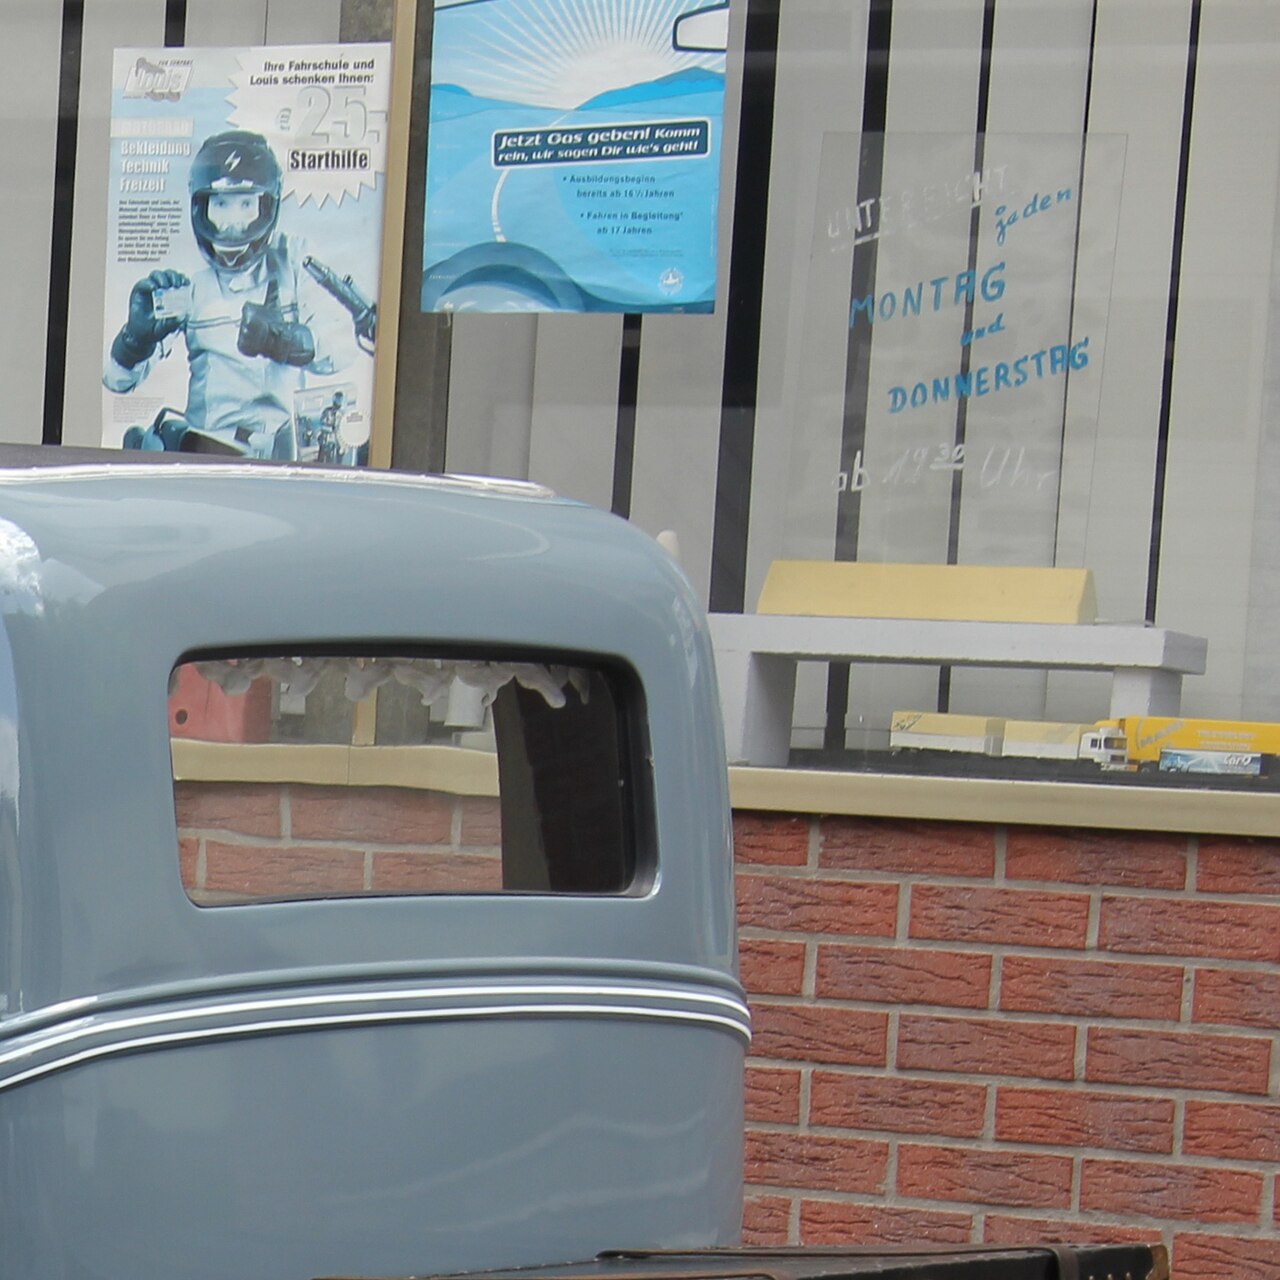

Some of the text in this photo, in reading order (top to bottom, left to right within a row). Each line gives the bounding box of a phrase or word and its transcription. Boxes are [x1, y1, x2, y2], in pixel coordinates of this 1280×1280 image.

[264, 59, 375, 72] Ihre Fahrschule und
[250, 73, 374, 86] Louis schenken Ihnen:
[498, 127, 700, 150] Jetzt Gas geben! Komm
[121, 140, 192, 156] Bekleidung
[498, 140, 698, 162] rein, wir sagen Dir wie's geht!
[121, 159, 169, 174] Technik
[290, 150, 368, 169] Starthilfe
[120, 178, 166, 192] Freizeit
[569, 174, 656, 184] Ausbildungsbeginn
[576, 189, 607, 198] bereits
[610, 189, 621, 198] ab
[644, 190, 675, 198] Jahren
[586, 211, 618, 220] Fahren
[621, 211, 629, 219] in
[597, 226, 608, 234] ab
[623, 226, 653, 235] Jahren
[849, 261, 1006, 329] MONTAG
[960, 313, 1006, 346] und
[887, 336, 1090, 414] DONNERSTAG
[830, 451, 871, 492] ab
